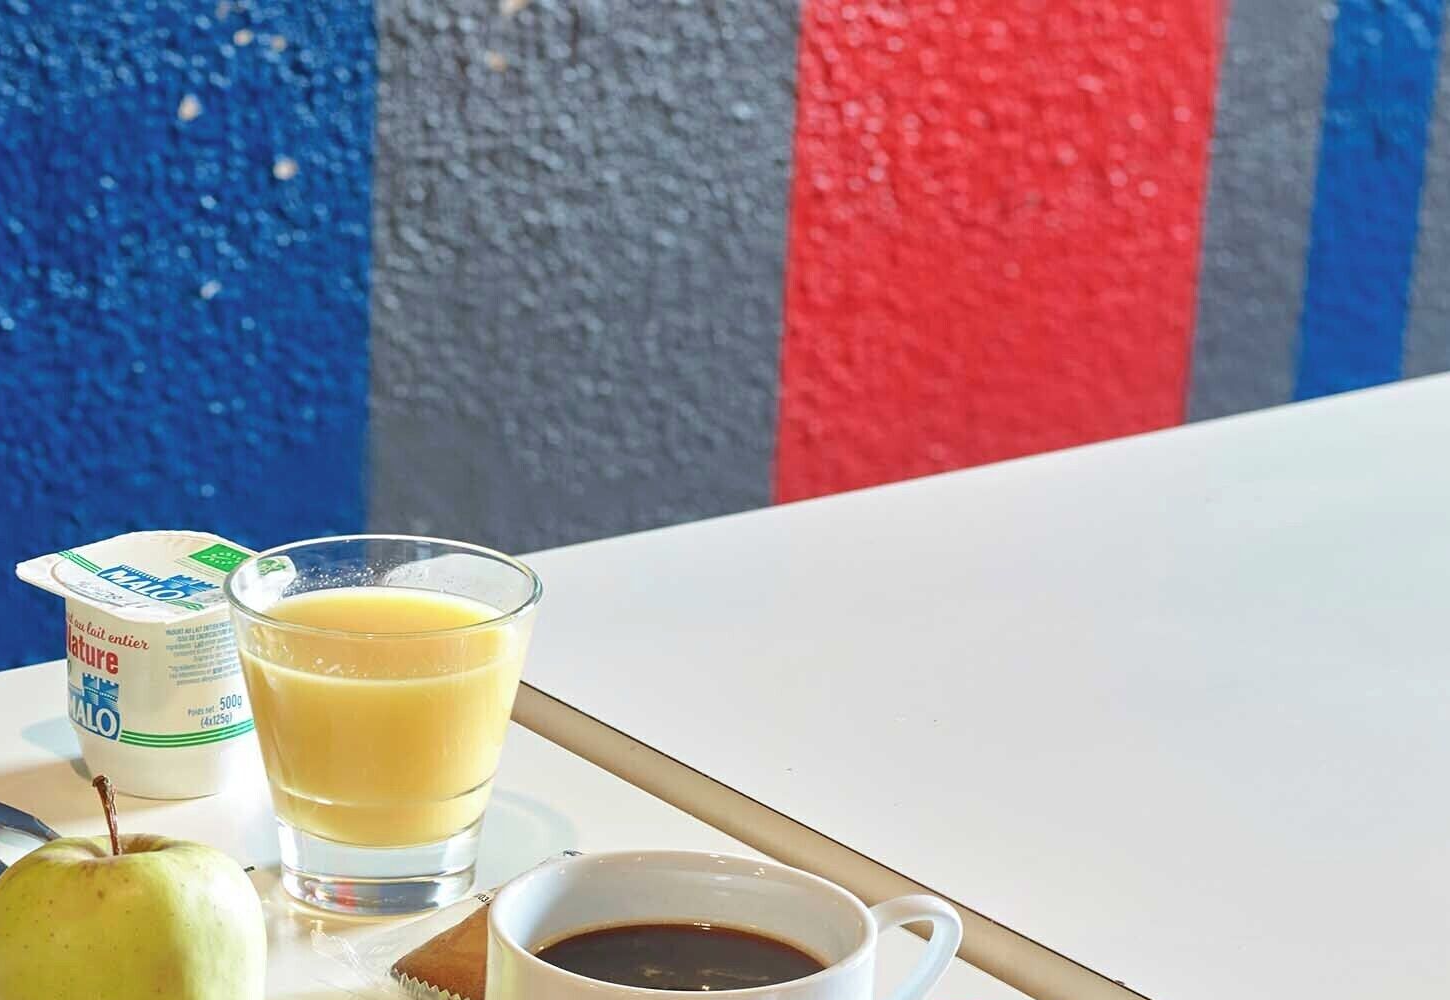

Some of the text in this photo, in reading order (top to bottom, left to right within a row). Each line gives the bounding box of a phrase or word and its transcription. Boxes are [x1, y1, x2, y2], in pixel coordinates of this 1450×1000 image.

[106, 568, 185, 600] MALO
[86, 621, 106, 641] lait
[109, 633, 150, 650] entier
[220, 694, 242, 711] 500g
